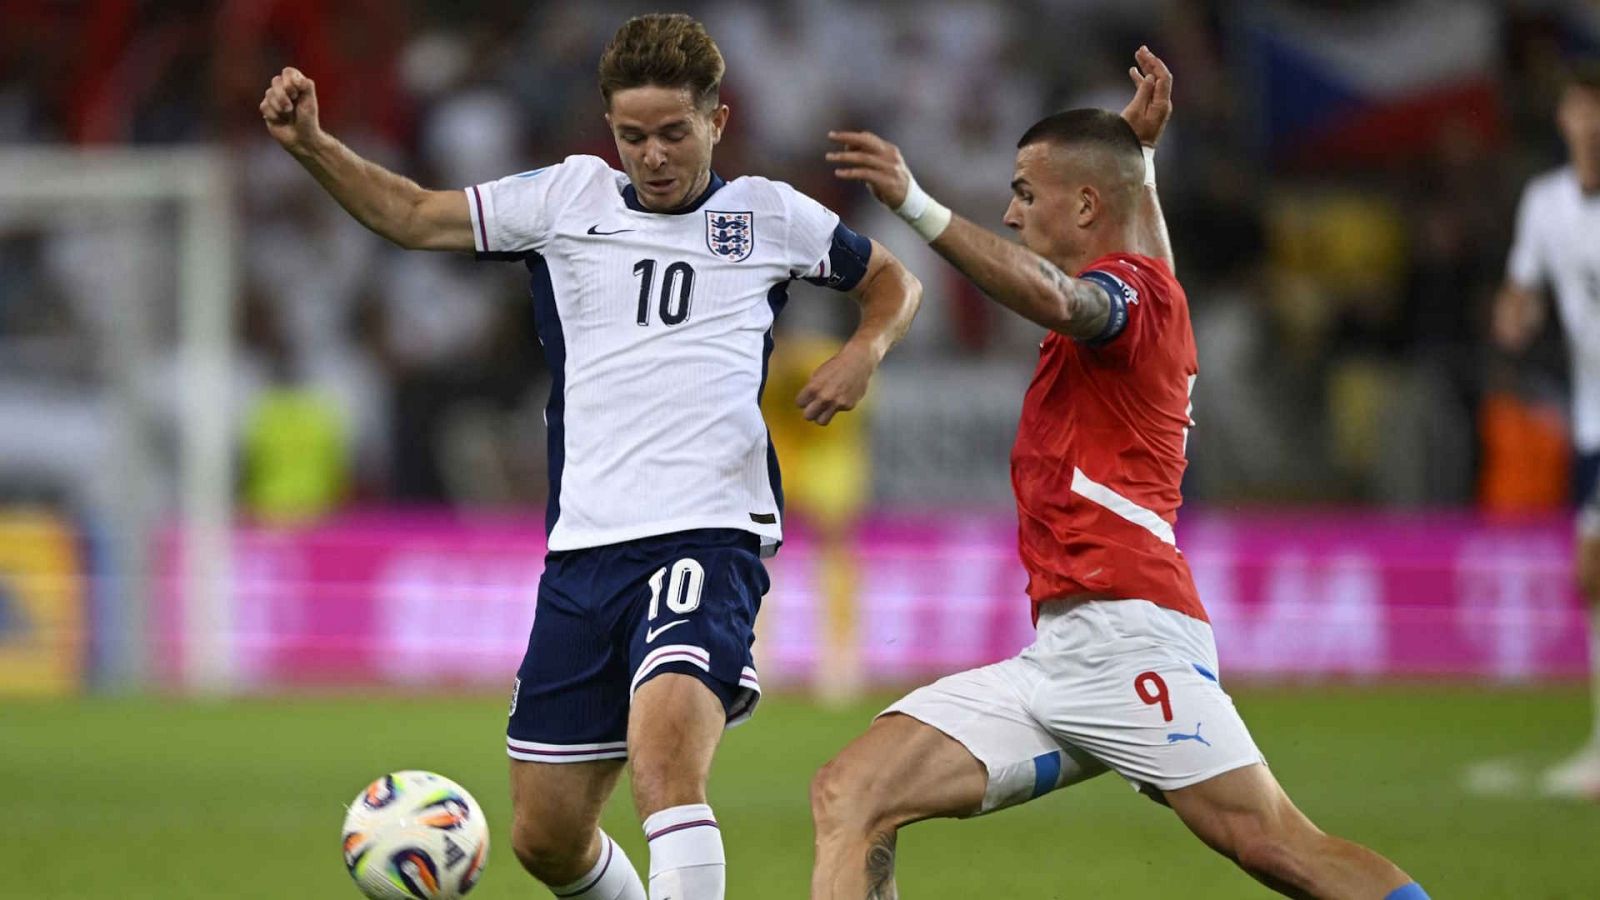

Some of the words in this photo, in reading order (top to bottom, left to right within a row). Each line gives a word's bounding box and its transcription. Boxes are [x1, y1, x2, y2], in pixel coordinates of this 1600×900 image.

[633, 258, 697, 327] 10
[648, 557, 706, 621] 10
[1134, 671, 1173, 722] 9
